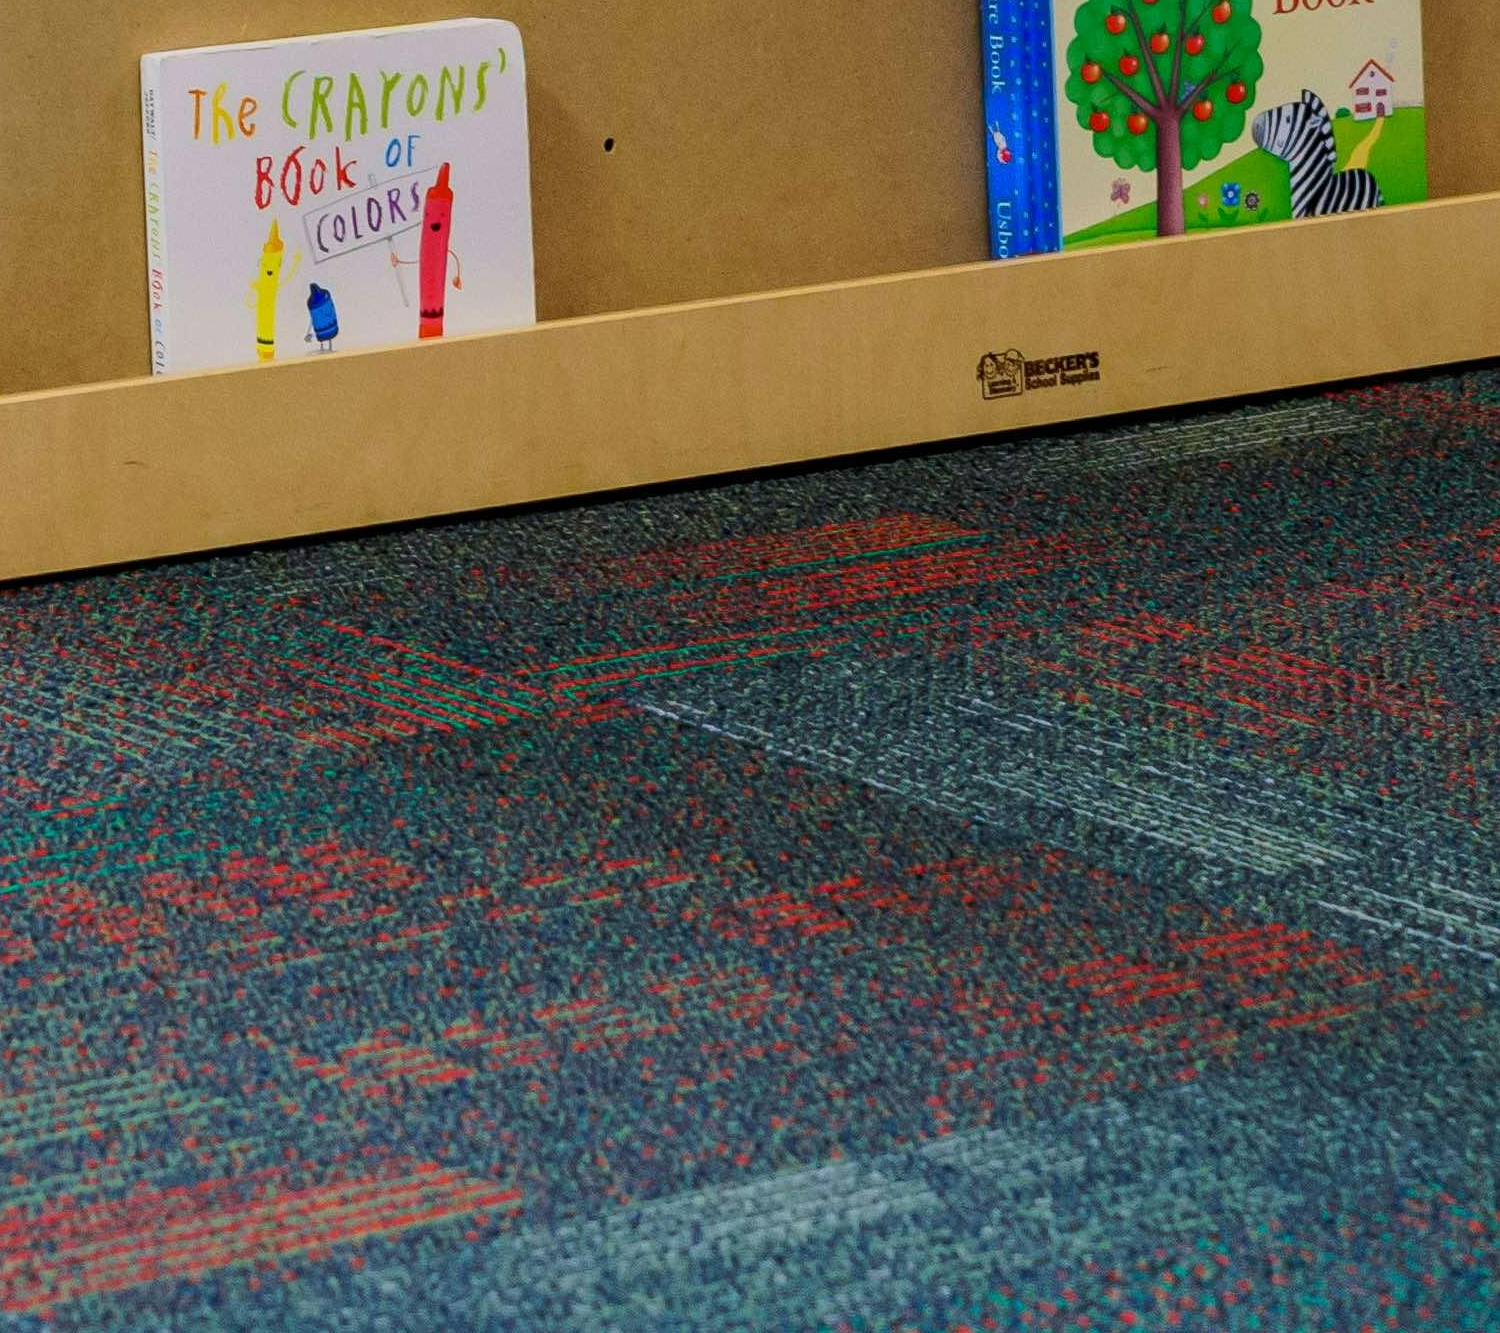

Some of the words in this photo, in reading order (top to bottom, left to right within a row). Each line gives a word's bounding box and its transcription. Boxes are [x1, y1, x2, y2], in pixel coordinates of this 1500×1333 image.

[281, 47, 507, 141] CRAYONS'
[989, 34, 1006, 94] Book
[385, 134, 420, 168] OF
[316, 182, 420, 253] COLORS
